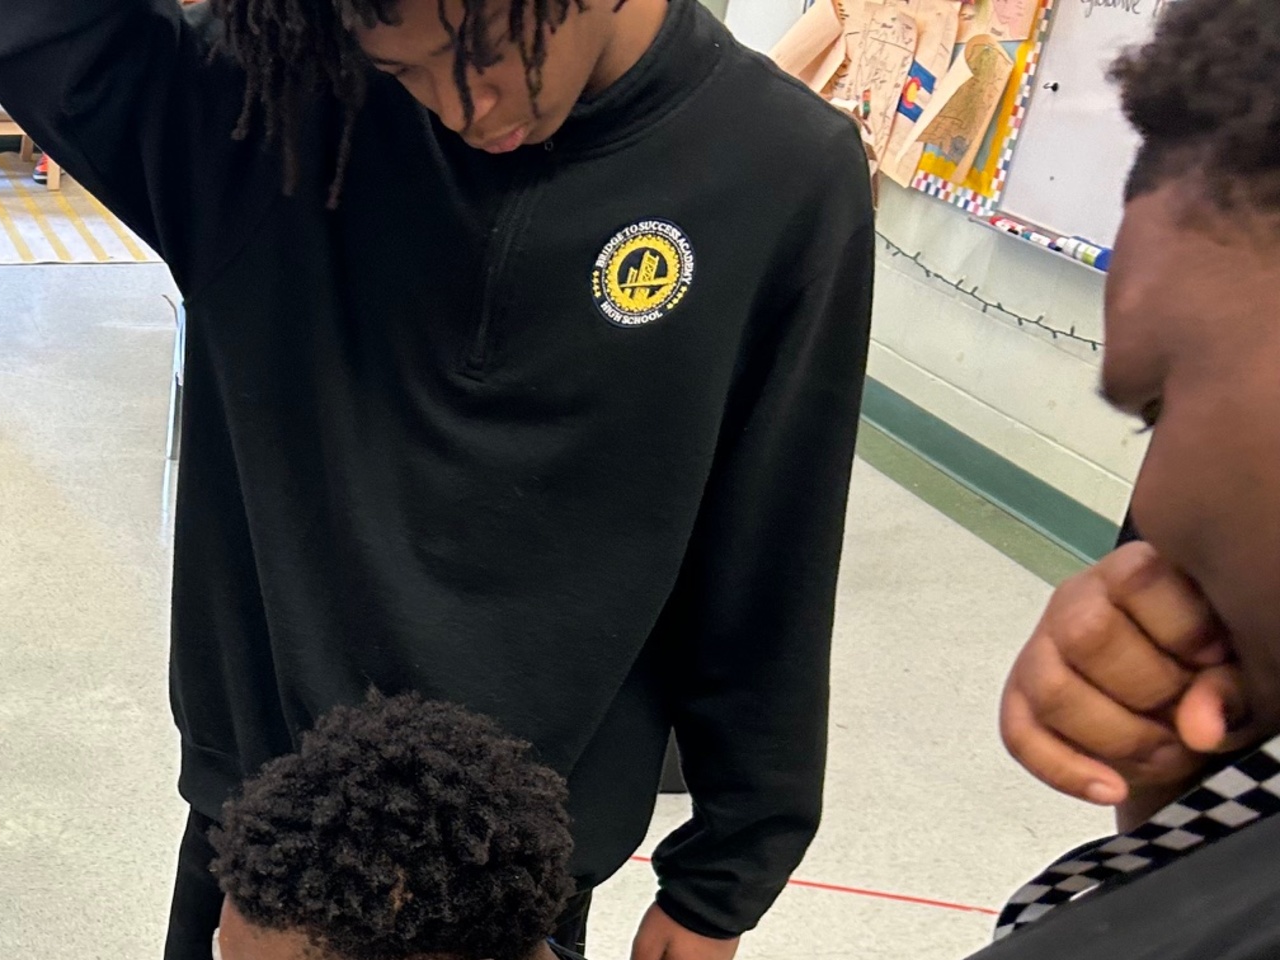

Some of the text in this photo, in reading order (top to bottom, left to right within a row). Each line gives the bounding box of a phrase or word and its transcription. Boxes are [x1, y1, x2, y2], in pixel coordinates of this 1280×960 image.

[596, 221, 694, 285] BRIDGE TO SUCCESS ACADEMY
[601, 301, 663, 324] HIGH SCHOOL
